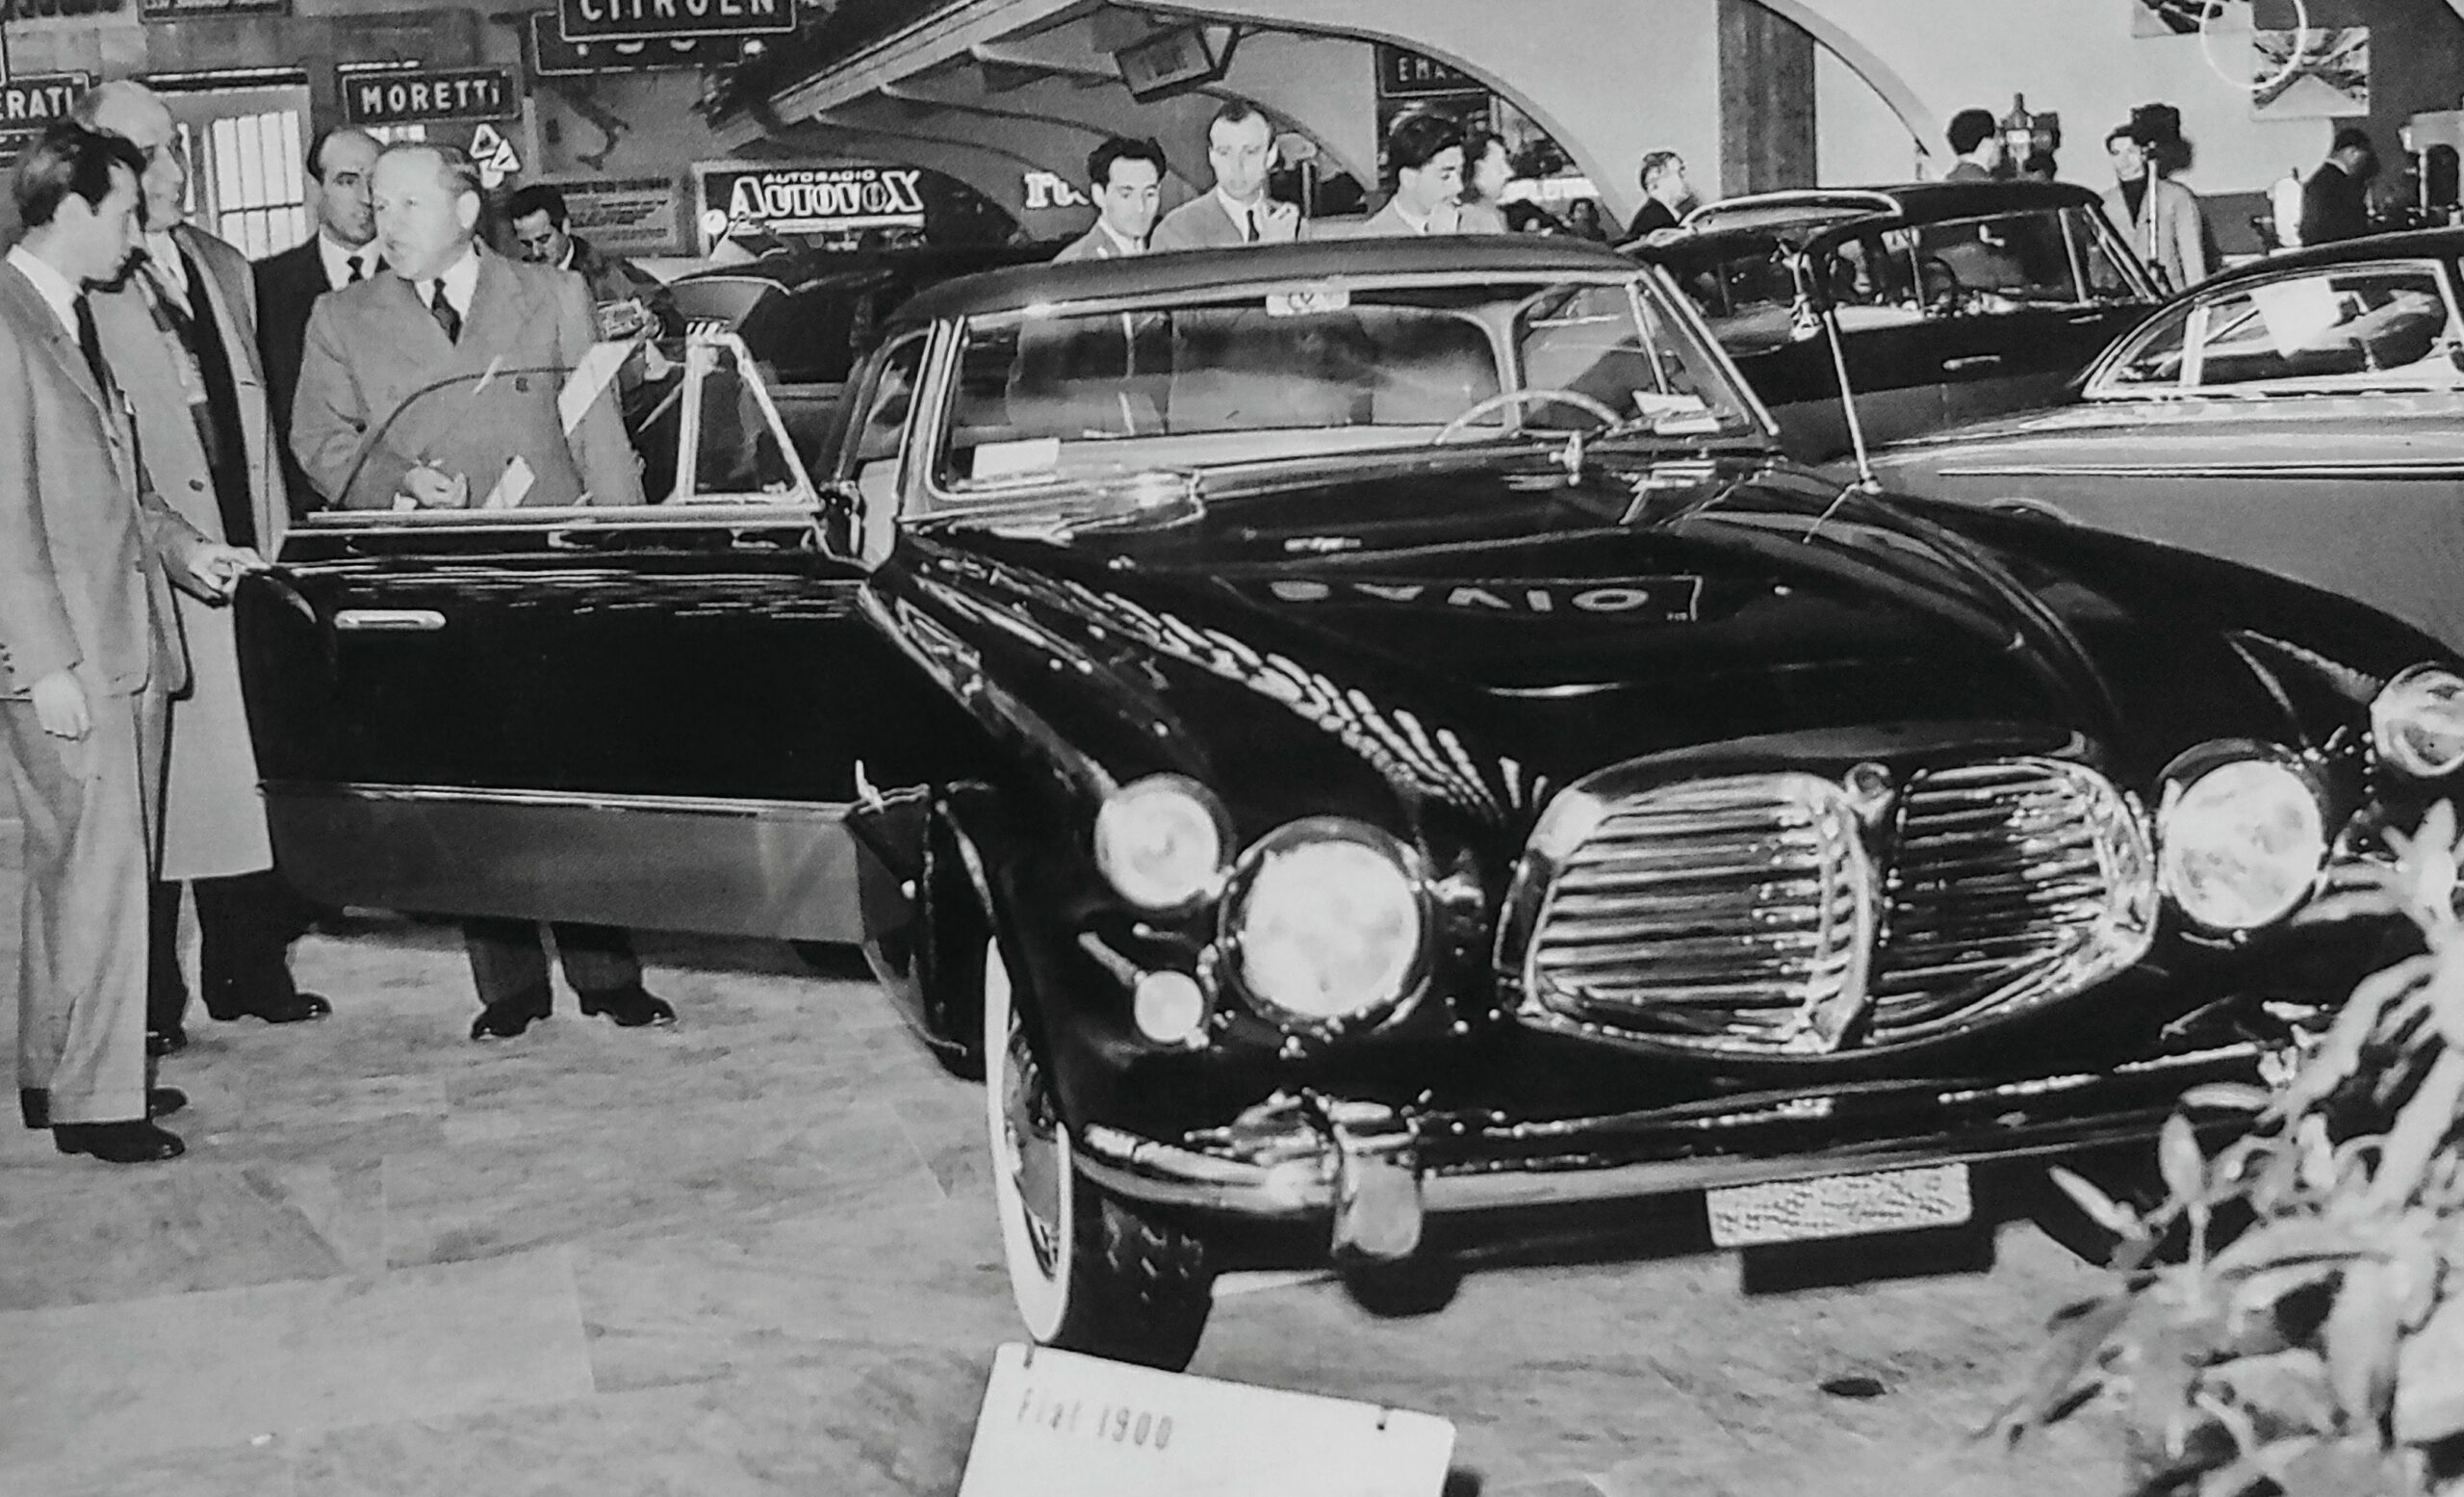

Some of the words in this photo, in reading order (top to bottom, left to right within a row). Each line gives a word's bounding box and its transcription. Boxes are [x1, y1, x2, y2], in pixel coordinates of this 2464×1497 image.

[0, 87, 74, 121] RATI
[361, 79, 500, 115] MORETTI
[1097, 1403, 1174, 1450] 1900
